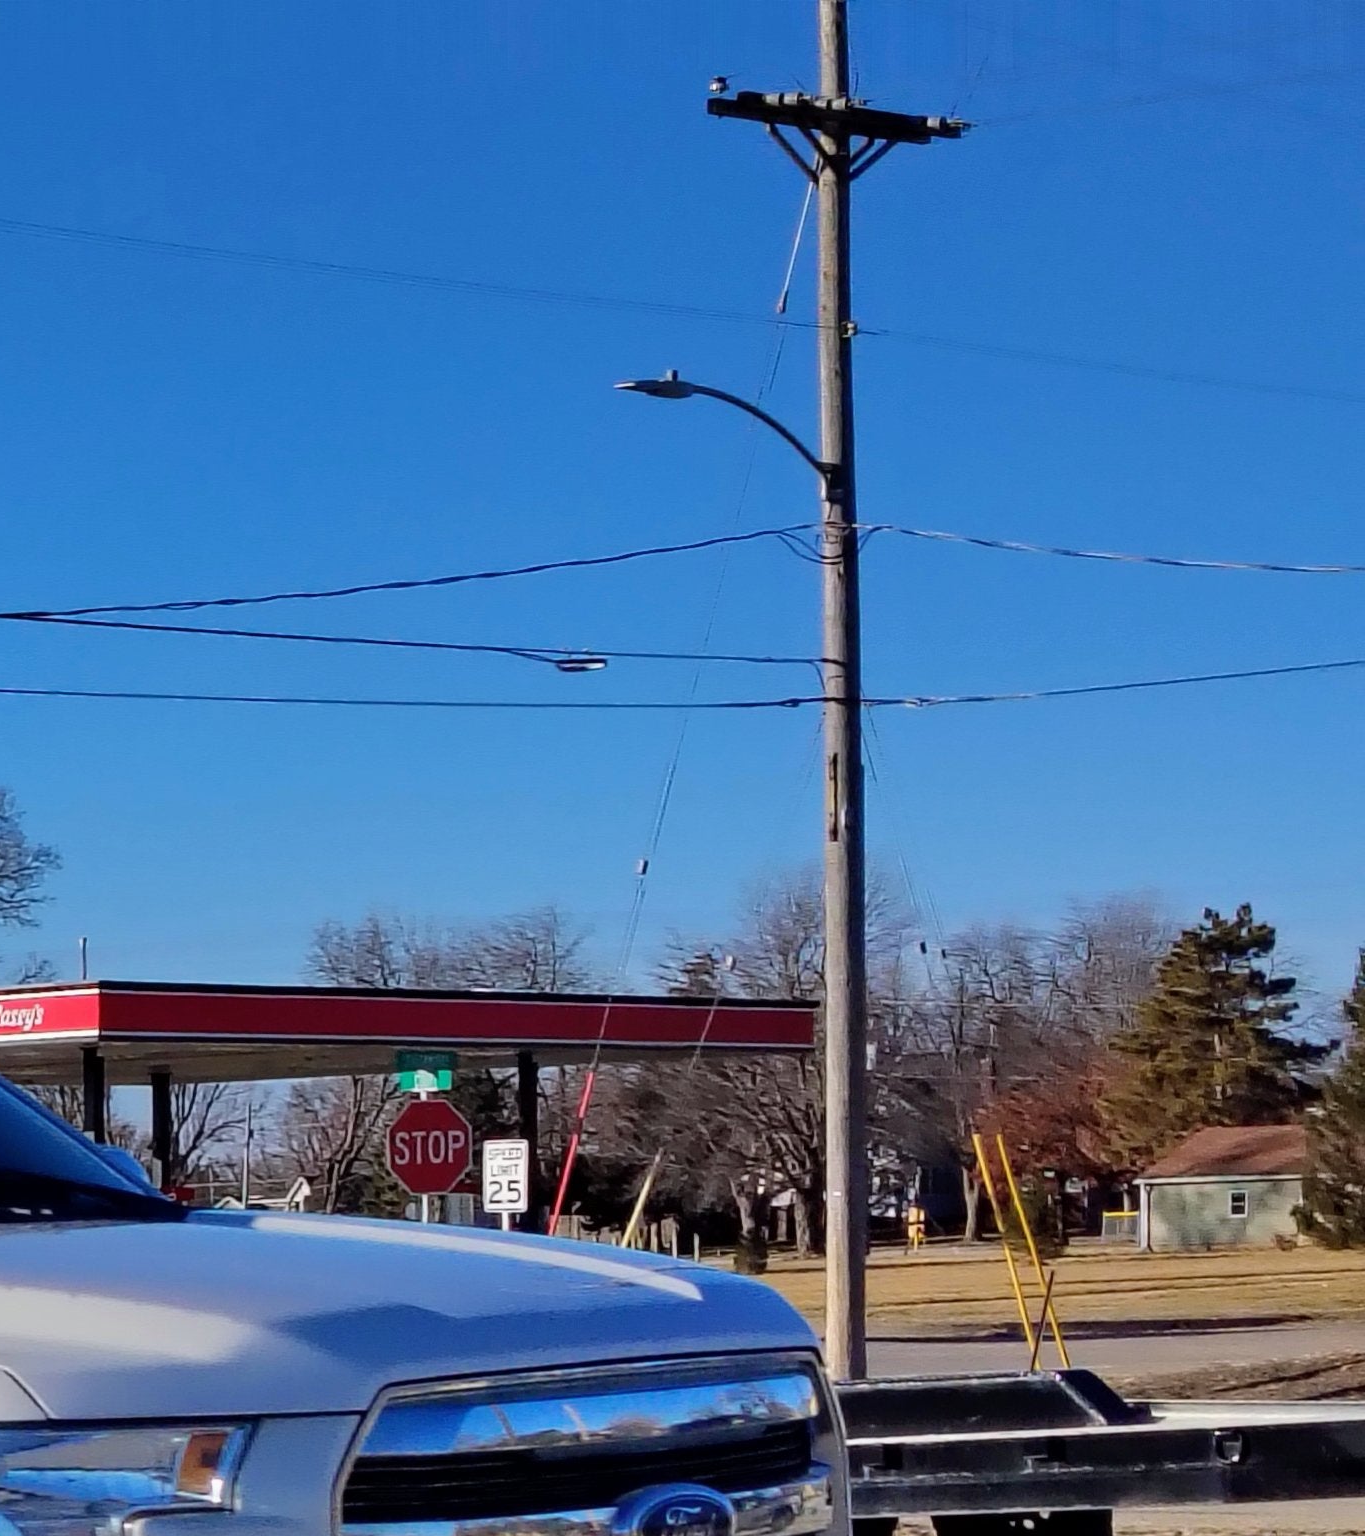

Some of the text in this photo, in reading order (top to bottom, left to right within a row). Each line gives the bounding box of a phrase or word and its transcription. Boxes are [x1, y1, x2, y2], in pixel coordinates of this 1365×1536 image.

[394, 1130, 465, 1165] STOP
[490, 1164, 519, 1177] LIMIT
[488, 1180, 521, 1204] 25
